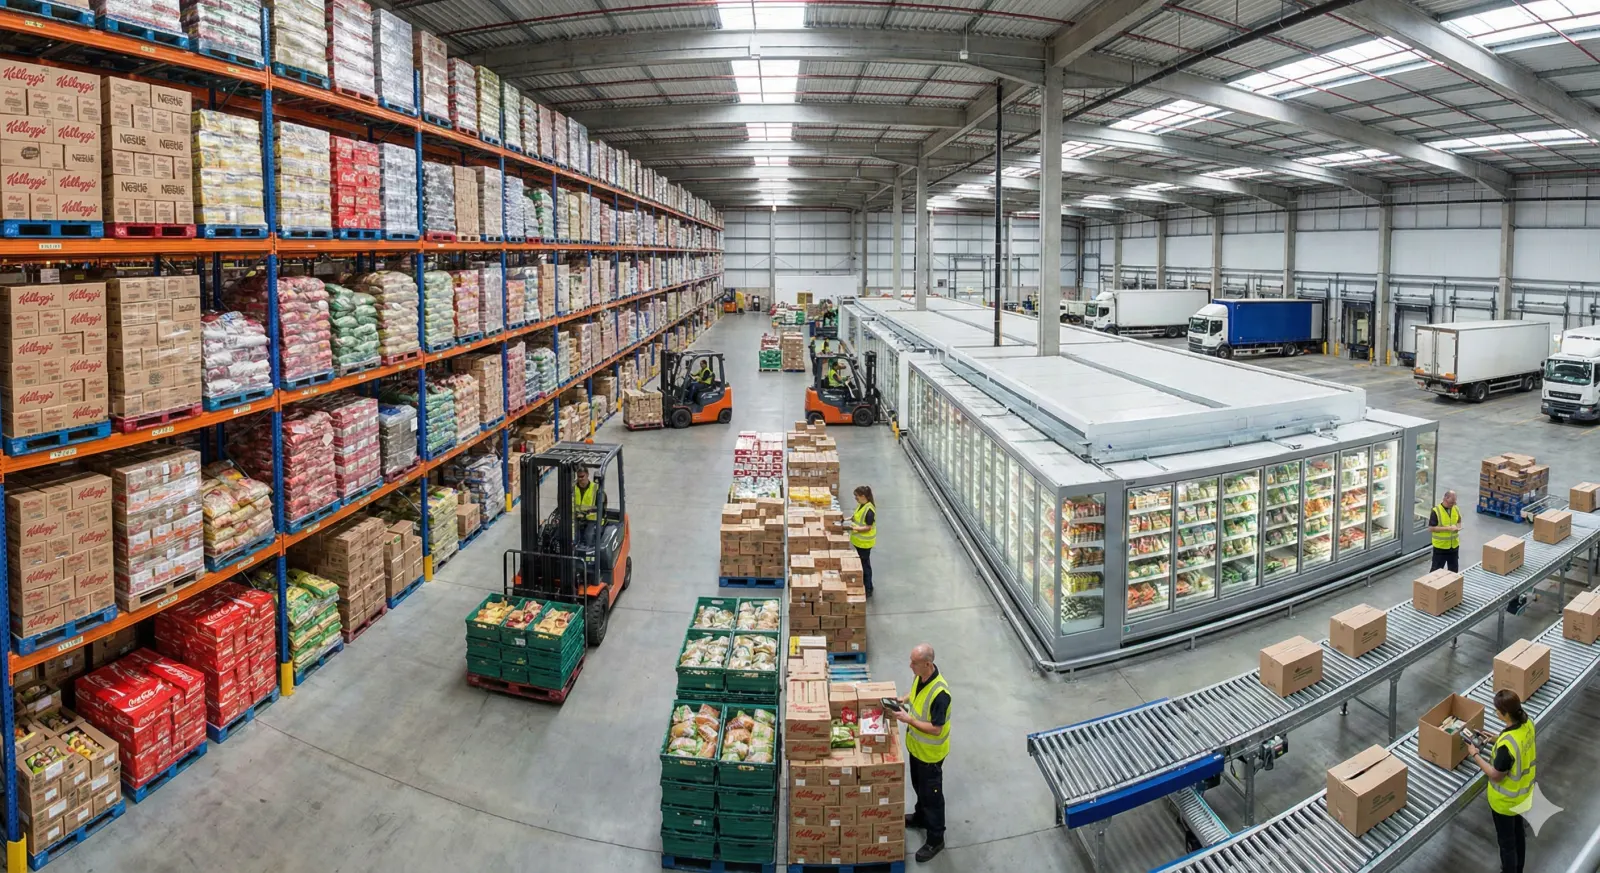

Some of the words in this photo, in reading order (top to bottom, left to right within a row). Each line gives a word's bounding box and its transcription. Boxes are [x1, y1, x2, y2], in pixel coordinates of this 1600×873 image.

[3, 66, 46, 86] Kellogg's
[56, 75, 95, 94] Kellogg's
[6, 120, 46, 138] Kellogg's
[58, 124, 96, 143] Kellogg's
[7, 172, 47, 190] Kellogg's
[60, 175, 96, 192] Kellogg's
[62, 200, 98, 217] Kellogg's
[18, 292, 54, 306] Kellogg's
[69, 289, 100, 302] Kellogg's
[70, 313, 102, 325] Kellogg's
[70, 359, 102, 373] Kellogg's
[20, 391, 54, 404] Kellogg's
